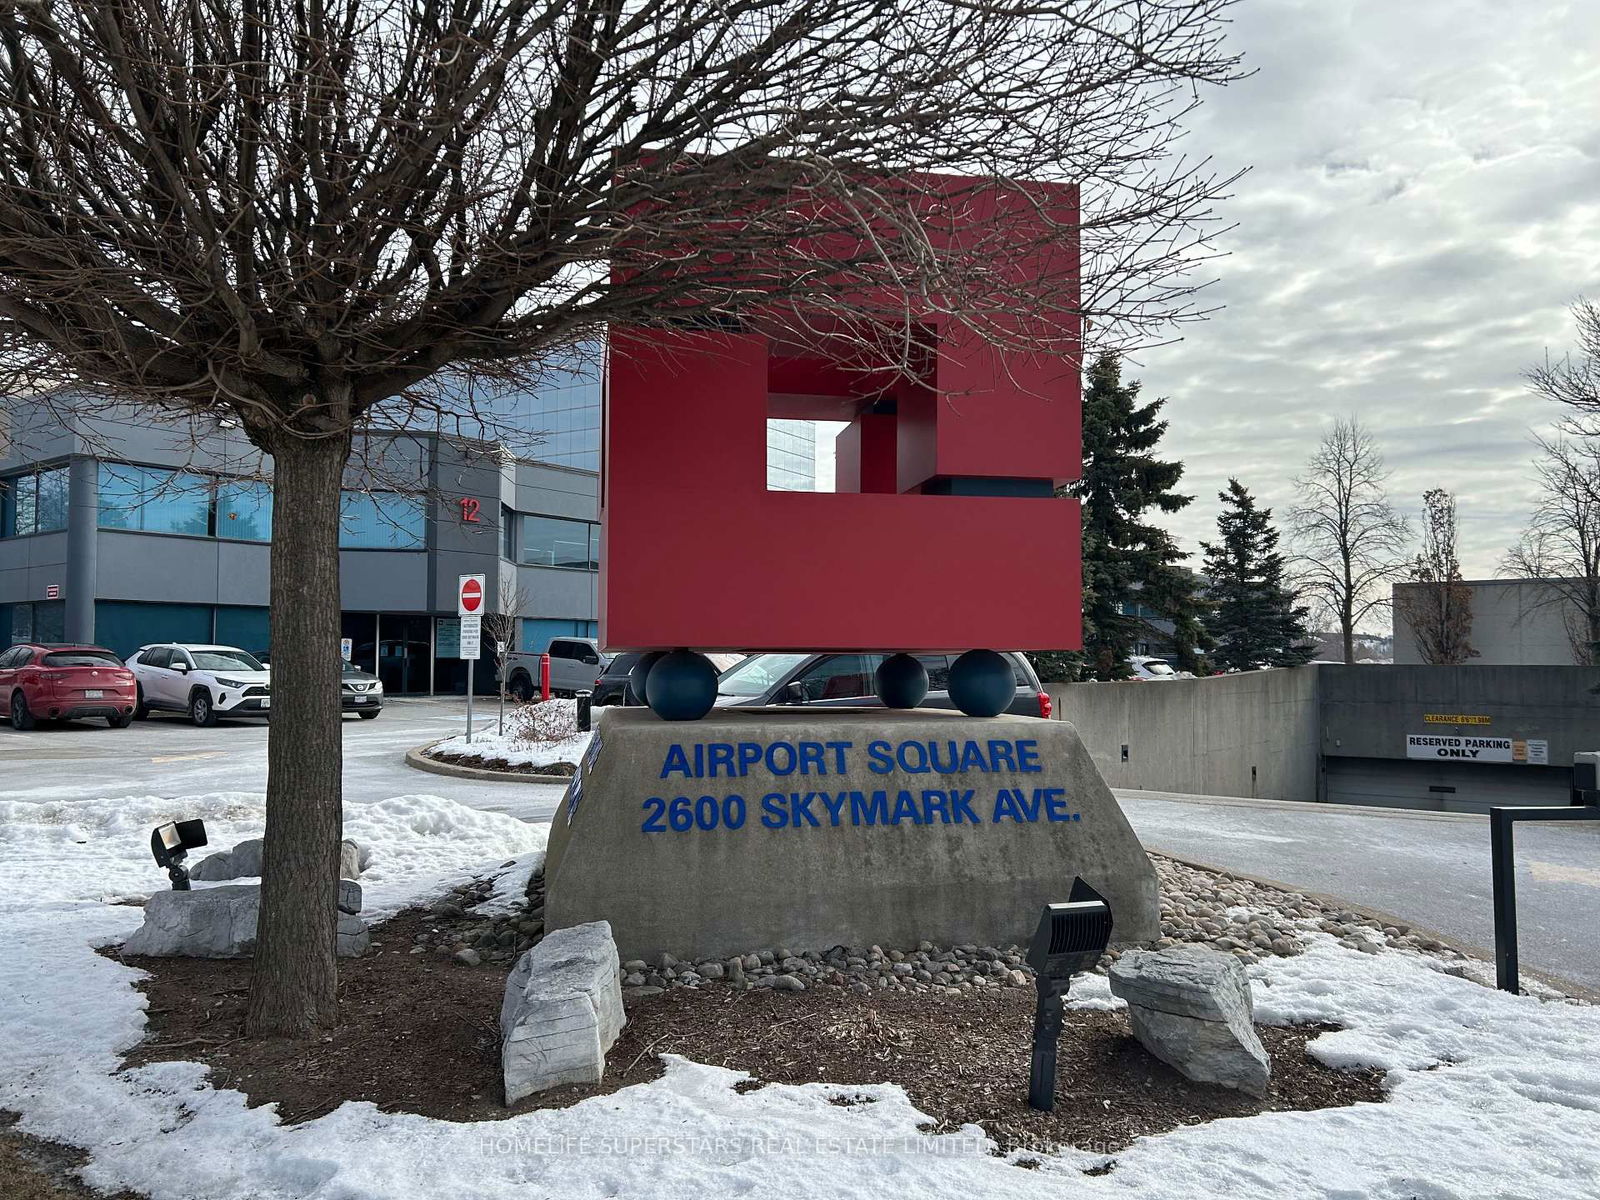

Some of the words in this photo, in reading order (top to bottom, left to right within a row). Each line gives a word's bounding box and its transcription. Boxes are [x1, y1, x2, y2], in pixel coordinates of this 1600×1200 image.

[460, 498, 481, 522] 12
[1424, 715, 1459, 723] CLEARANCE
[1409, 737, 1461, 747] RESERVED
[1465, 740, 1510, 749] PARKING
[660, 741, 853, 779] AIRPORT
[868, 740, 1042, 774] SQUARE
[1437, 749, 1479, 757] ONLY
[642, 795, 746, 833] 2600
[760, 788, 981, 829] SKYMARK
[992, 788, 1081, 823] AVE.
